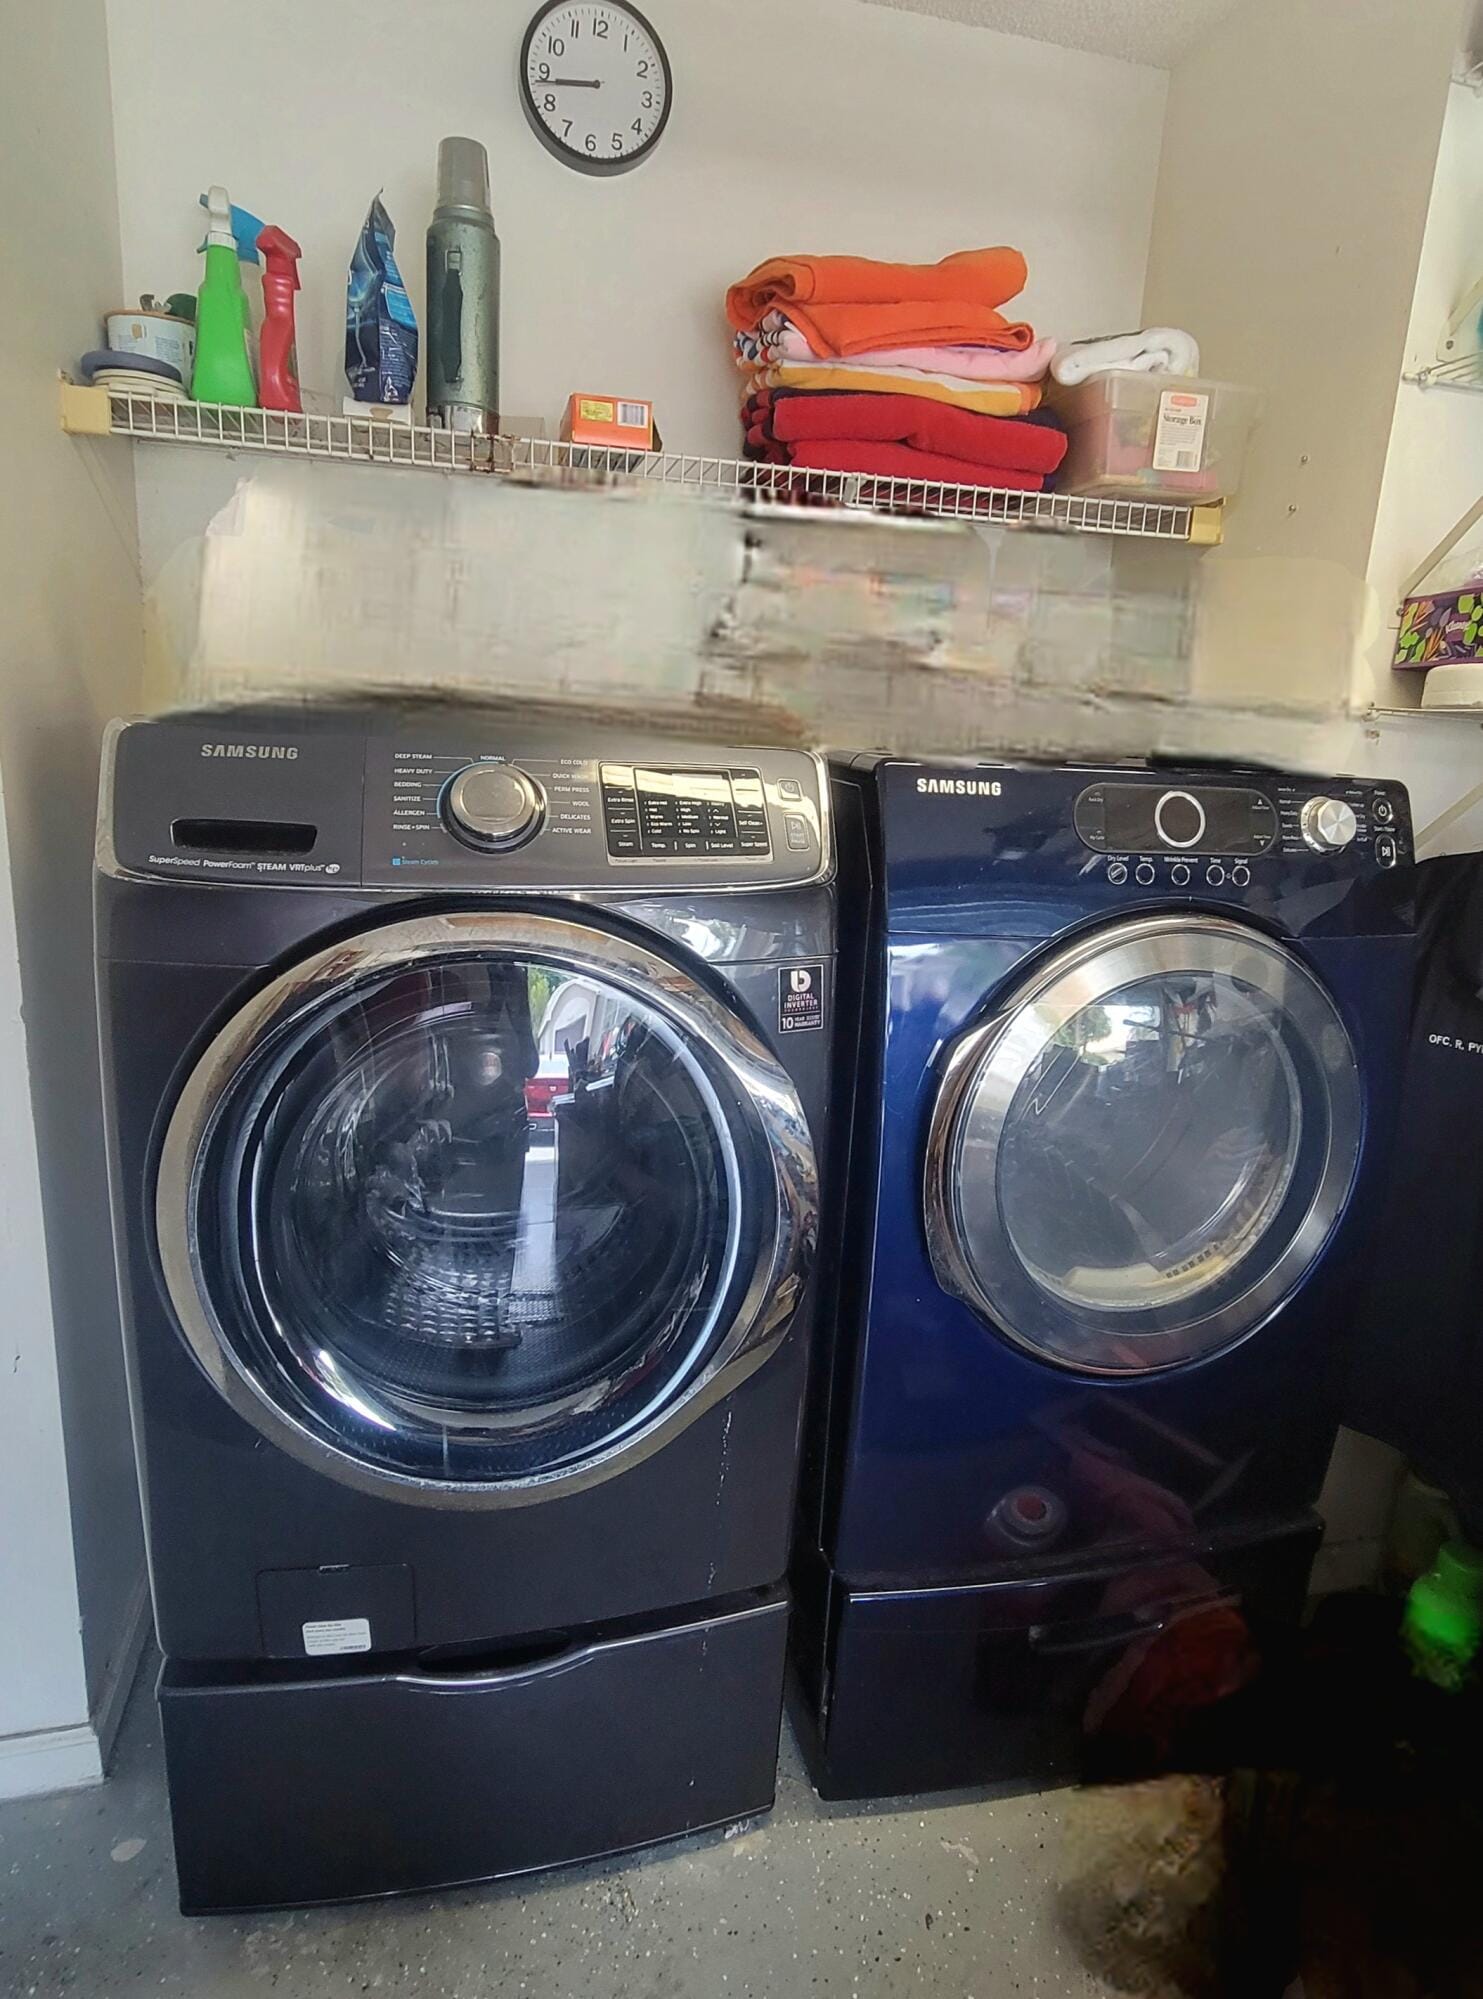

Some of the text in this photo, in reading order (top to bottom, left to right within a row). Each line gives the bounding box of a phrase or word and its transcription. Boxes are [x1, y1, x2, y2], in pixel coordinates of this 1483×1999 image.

[571, 19, 579, 39] 11
[593, 18, 609, 39] 12
[549, 36, 565, 56] 10
[623, 34, 628, 52] 1
[538, 62, 550, 80] 9
[636, 60, 648, 78] 2
[543, 94, 556, 112] 8
[641, 91, 653, 108] 3
[561, 119, 573, 137] 7
[631, 118, 642, 135] 4
[585, 134, 596, 151] 6
[611, 133, 623, 150] 5
[201, 744, 298, 760] SAMSUNG
[917, 778, 1001, 796] SAMSUNG
[149, 855, 200, 866] SuperSpeed
[784, 999, 818, 1009] INVERTER
[787, 993, 815, 1002] DIGITAL
[782, 1016, 794, 1029] 10
[1429, 1034, 1452, 1047] OFC.
[1455, 1039, 1464, 1050] R.
